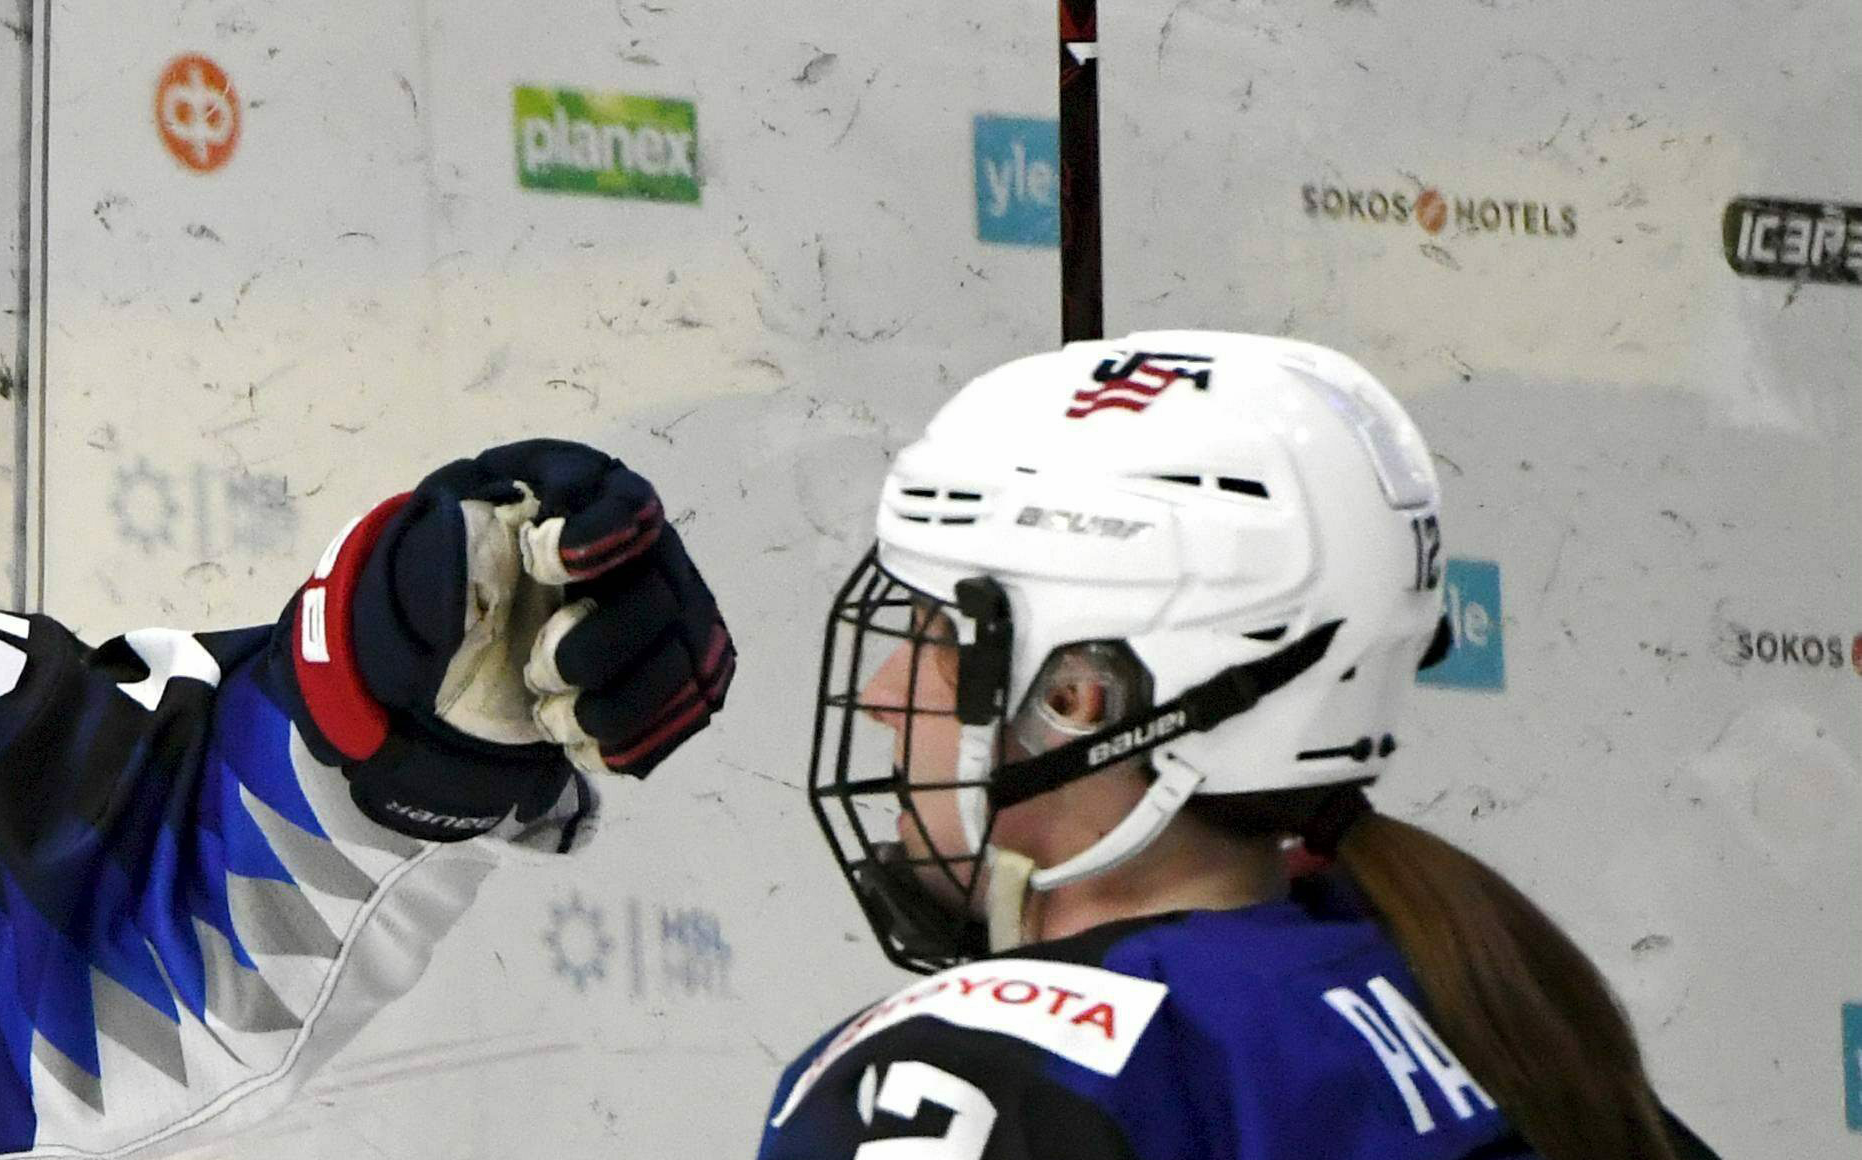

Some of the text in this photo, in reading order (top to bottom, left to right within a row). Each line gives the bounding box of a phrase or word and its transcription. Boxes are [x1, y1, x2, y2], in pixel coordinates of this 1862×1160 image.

[525, 104, 692, 178] planex
[985, 139, 1054, 217] yle
[1301, 182, 1577, 238] SOKOS HOTELS
[1738, 629, 1844, 668] SOKOS
[928, 978, 1116, 1039] YOTA
